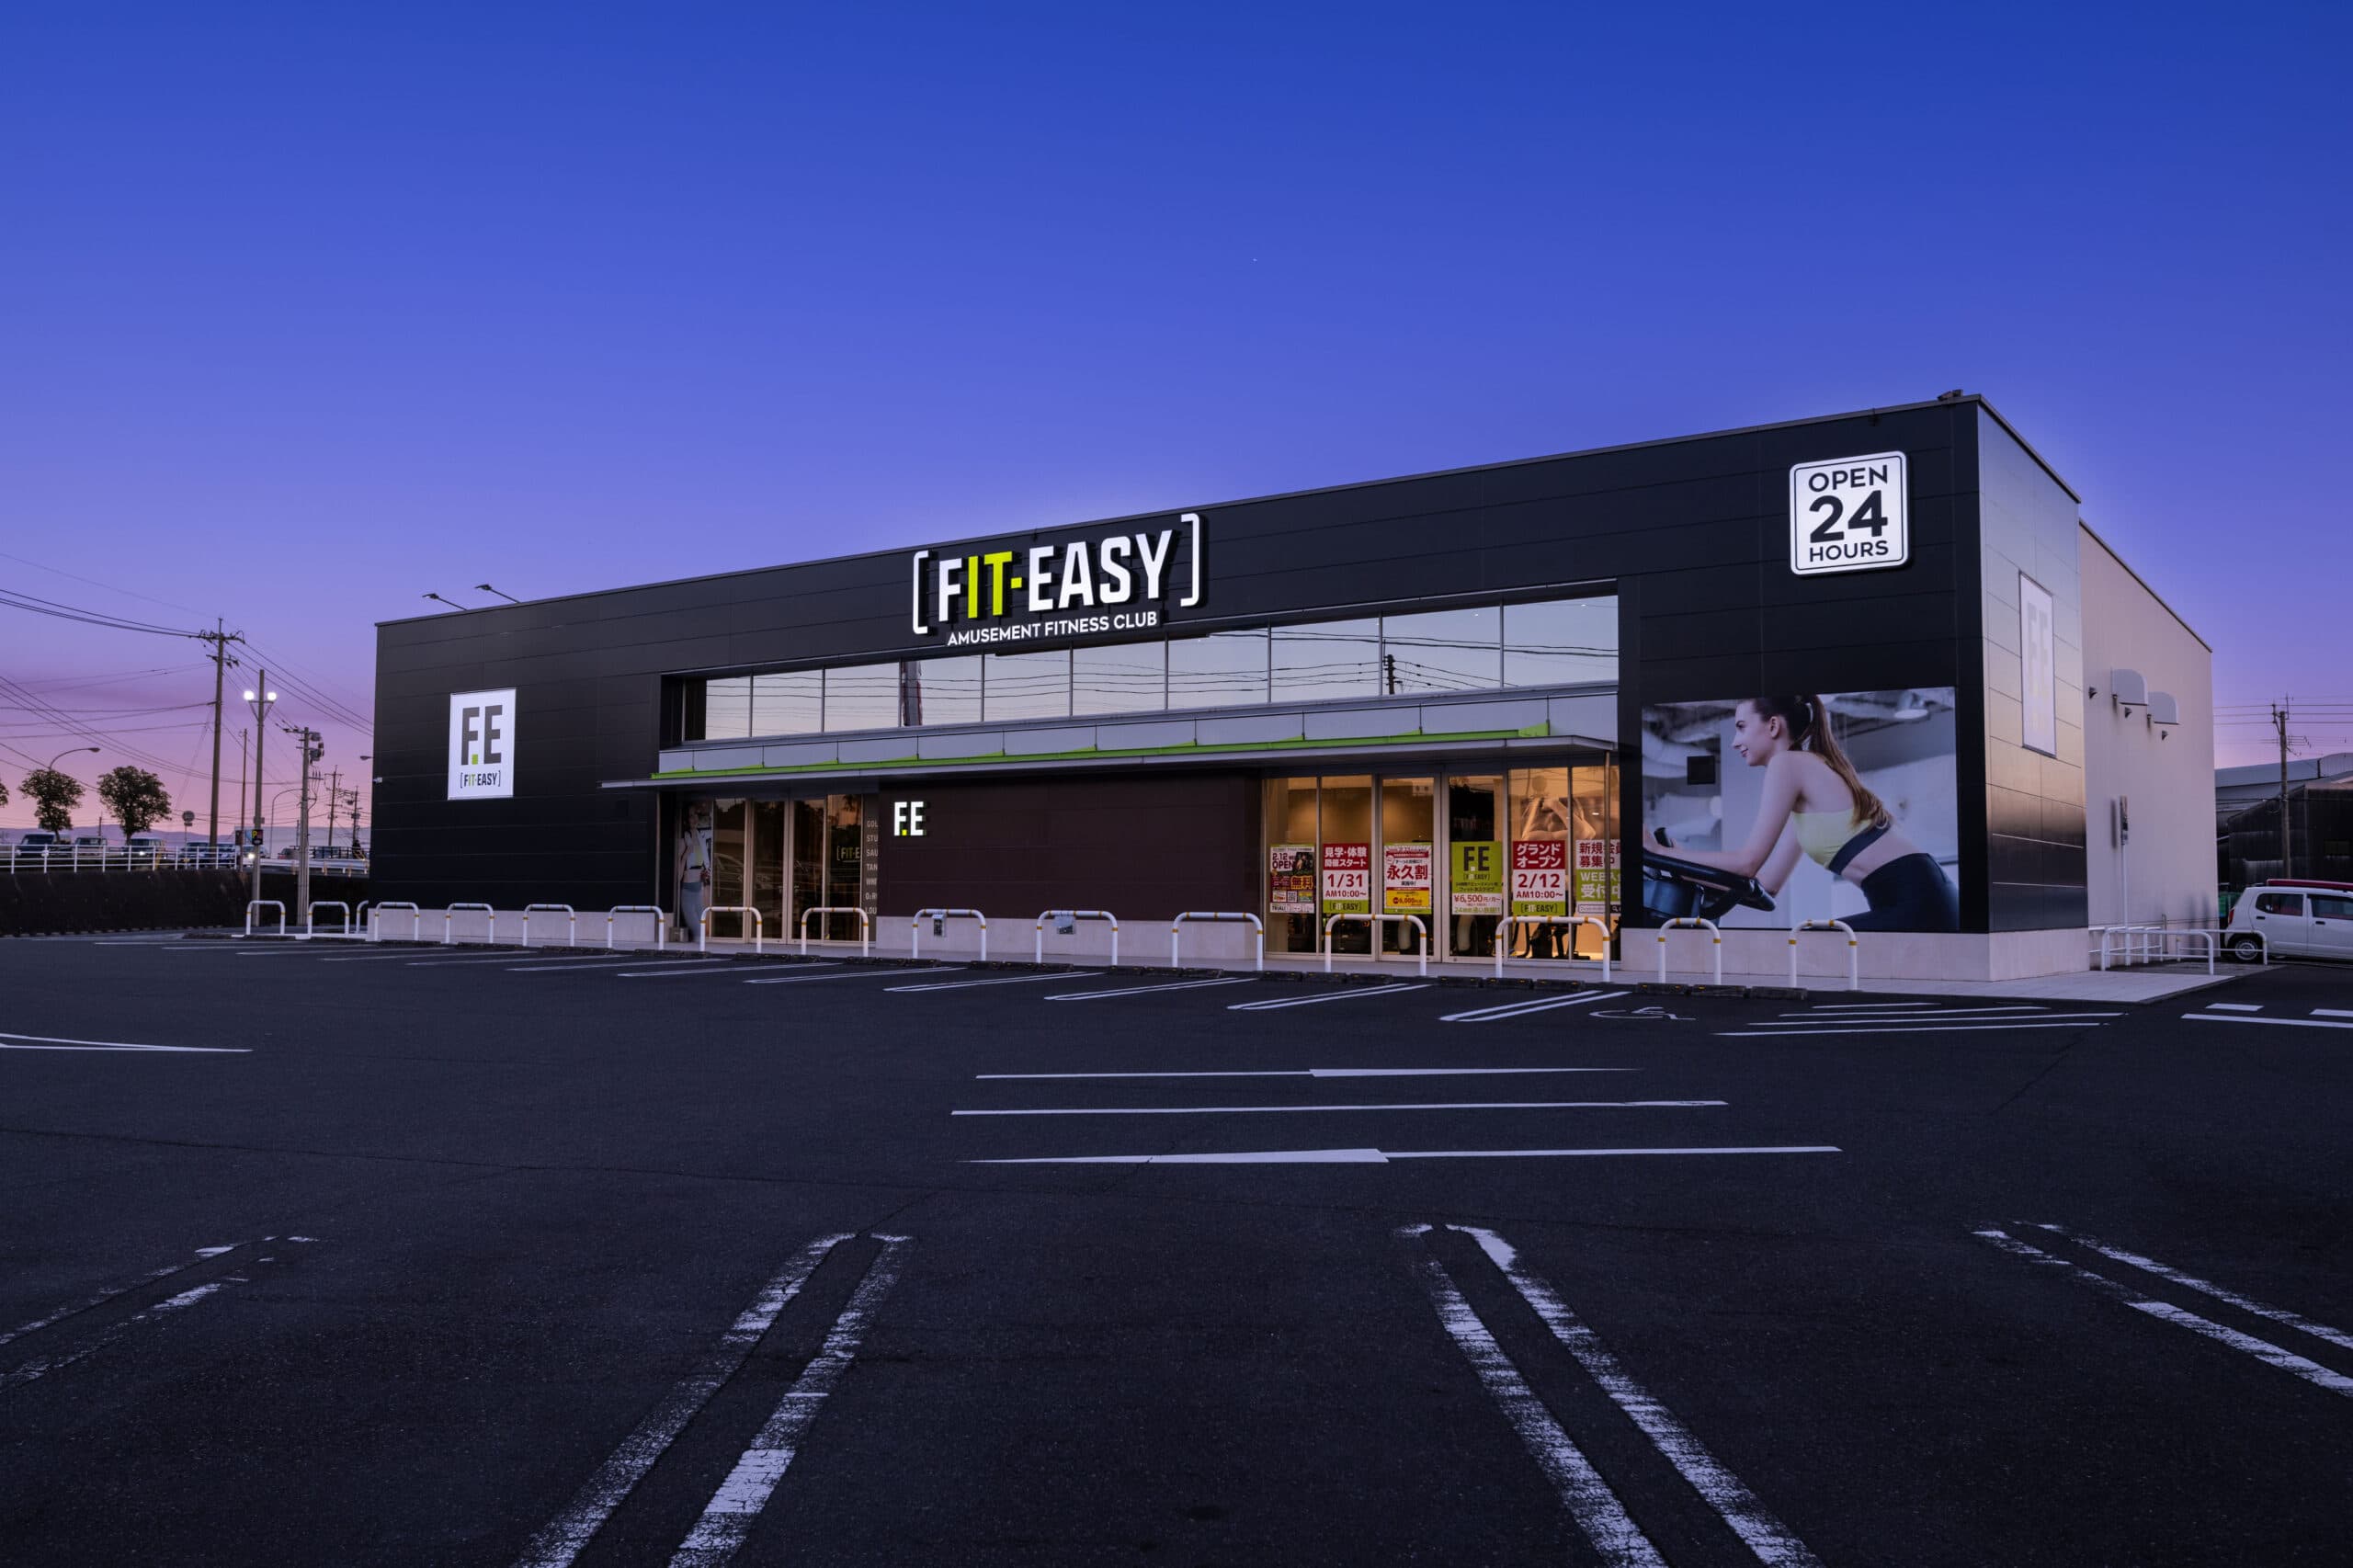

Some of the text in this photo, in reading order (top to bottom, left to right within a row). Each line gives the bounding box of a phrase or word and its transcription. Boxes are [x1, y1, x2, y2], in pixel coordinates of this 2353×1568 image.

[1809, 464, 1888, 492] OPEN
[1809, 490, 1888, 543] 24
[1810, 540, 1889, 562] HOURS
[947, 610, 1157, 646] AMUSEMENT FITNESS CLUB
[1324, 846, 1367, 858] 見学・体験
[1517, 843, 1562, 855] グランド
[1272, 861, 1295, 869] OPEN
[1517, 856, 1562, 868] オープン
[1386, 865, 1428, 880] 永久割
[1580, 871, 1621, 881] WEB入
[1327, 874, 1363, 888] 1/31
[1518, 874, 1561, 888] 2/12
